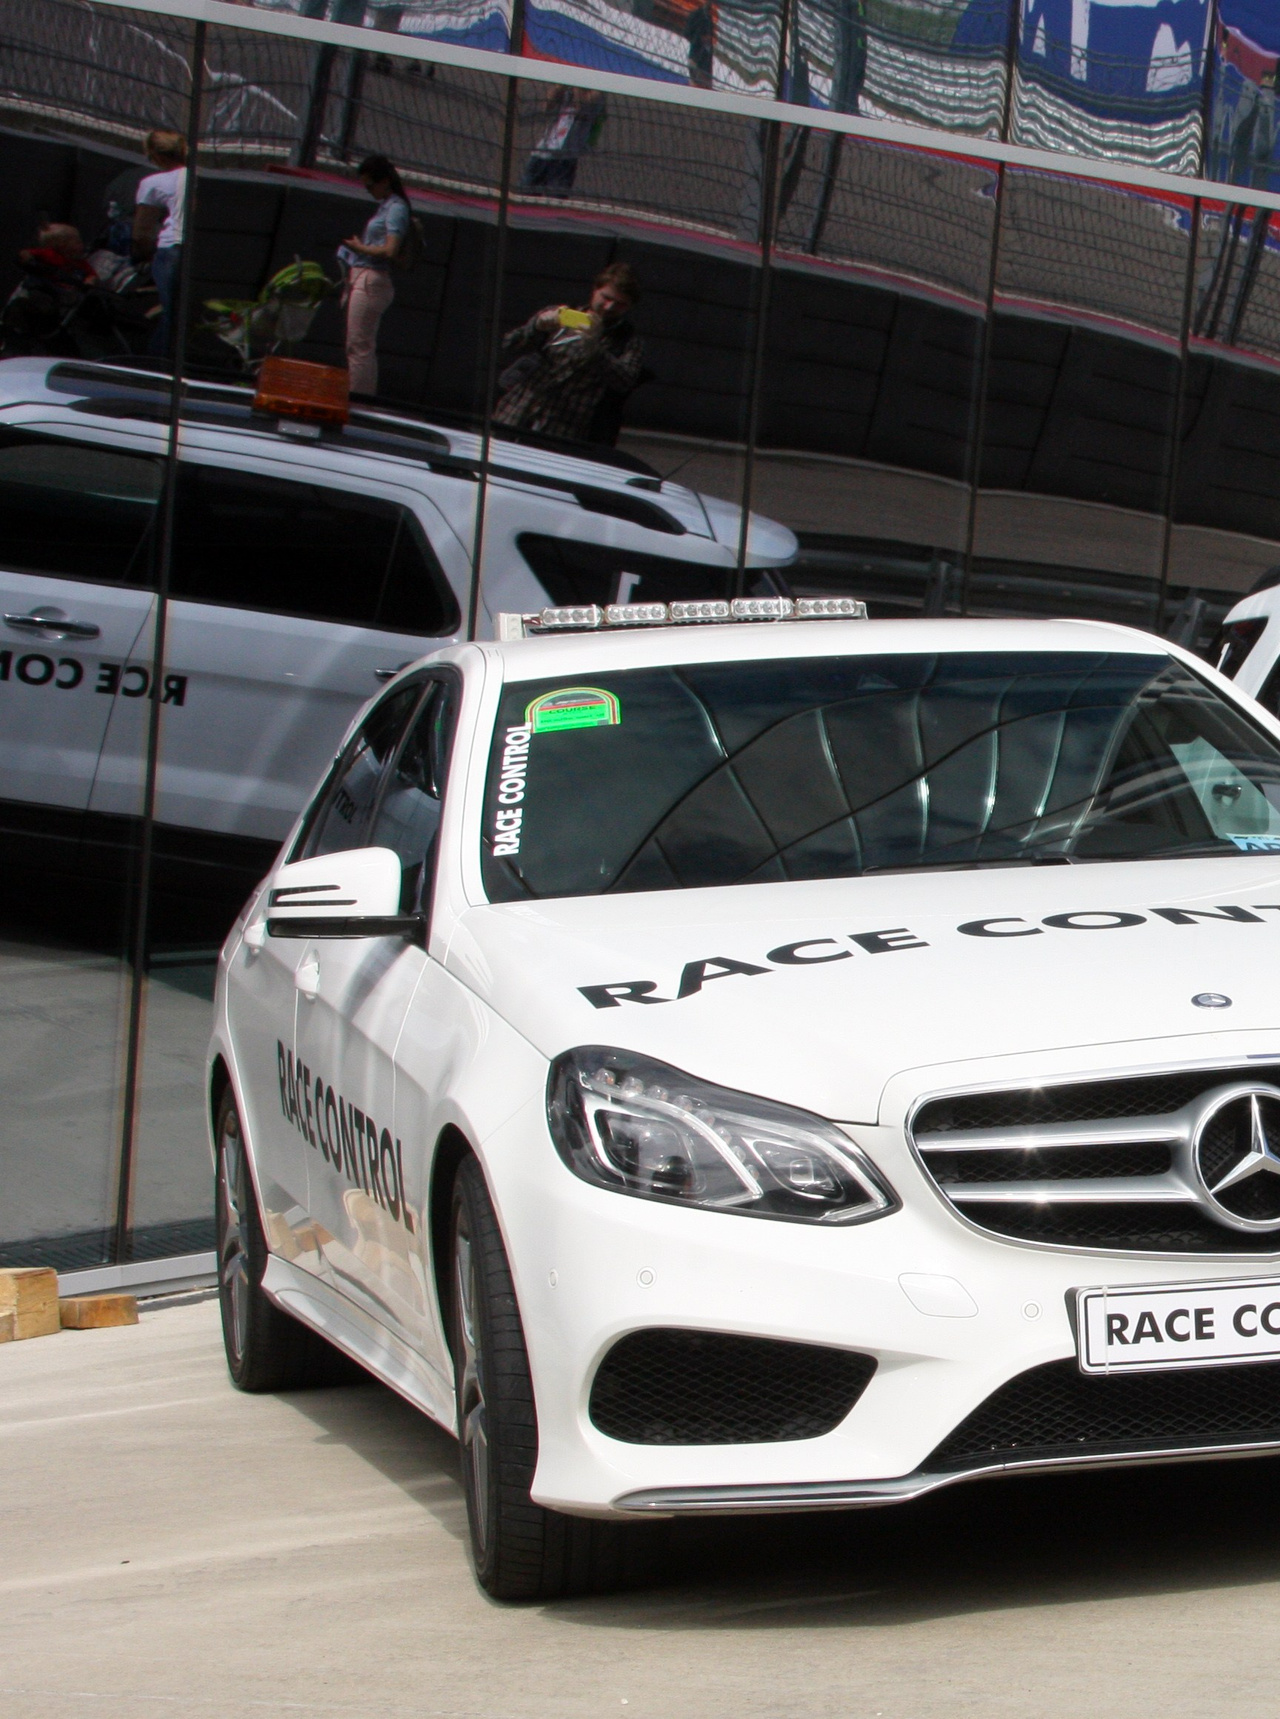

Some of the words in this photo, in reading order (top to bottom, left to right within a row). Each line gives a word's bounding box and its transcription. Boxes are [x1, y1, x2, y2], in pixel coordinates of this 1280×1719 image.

[498, 721, 532, 804] CONTROL
[493, 808, 523, 857] RACE
[576, 927, 931, 1009] RACE
[277, 1038, 317, 1150] RACE
[315, 1076, 415, 1235] CONTROL
[1107, 1307, 1216, 1346] RACE
